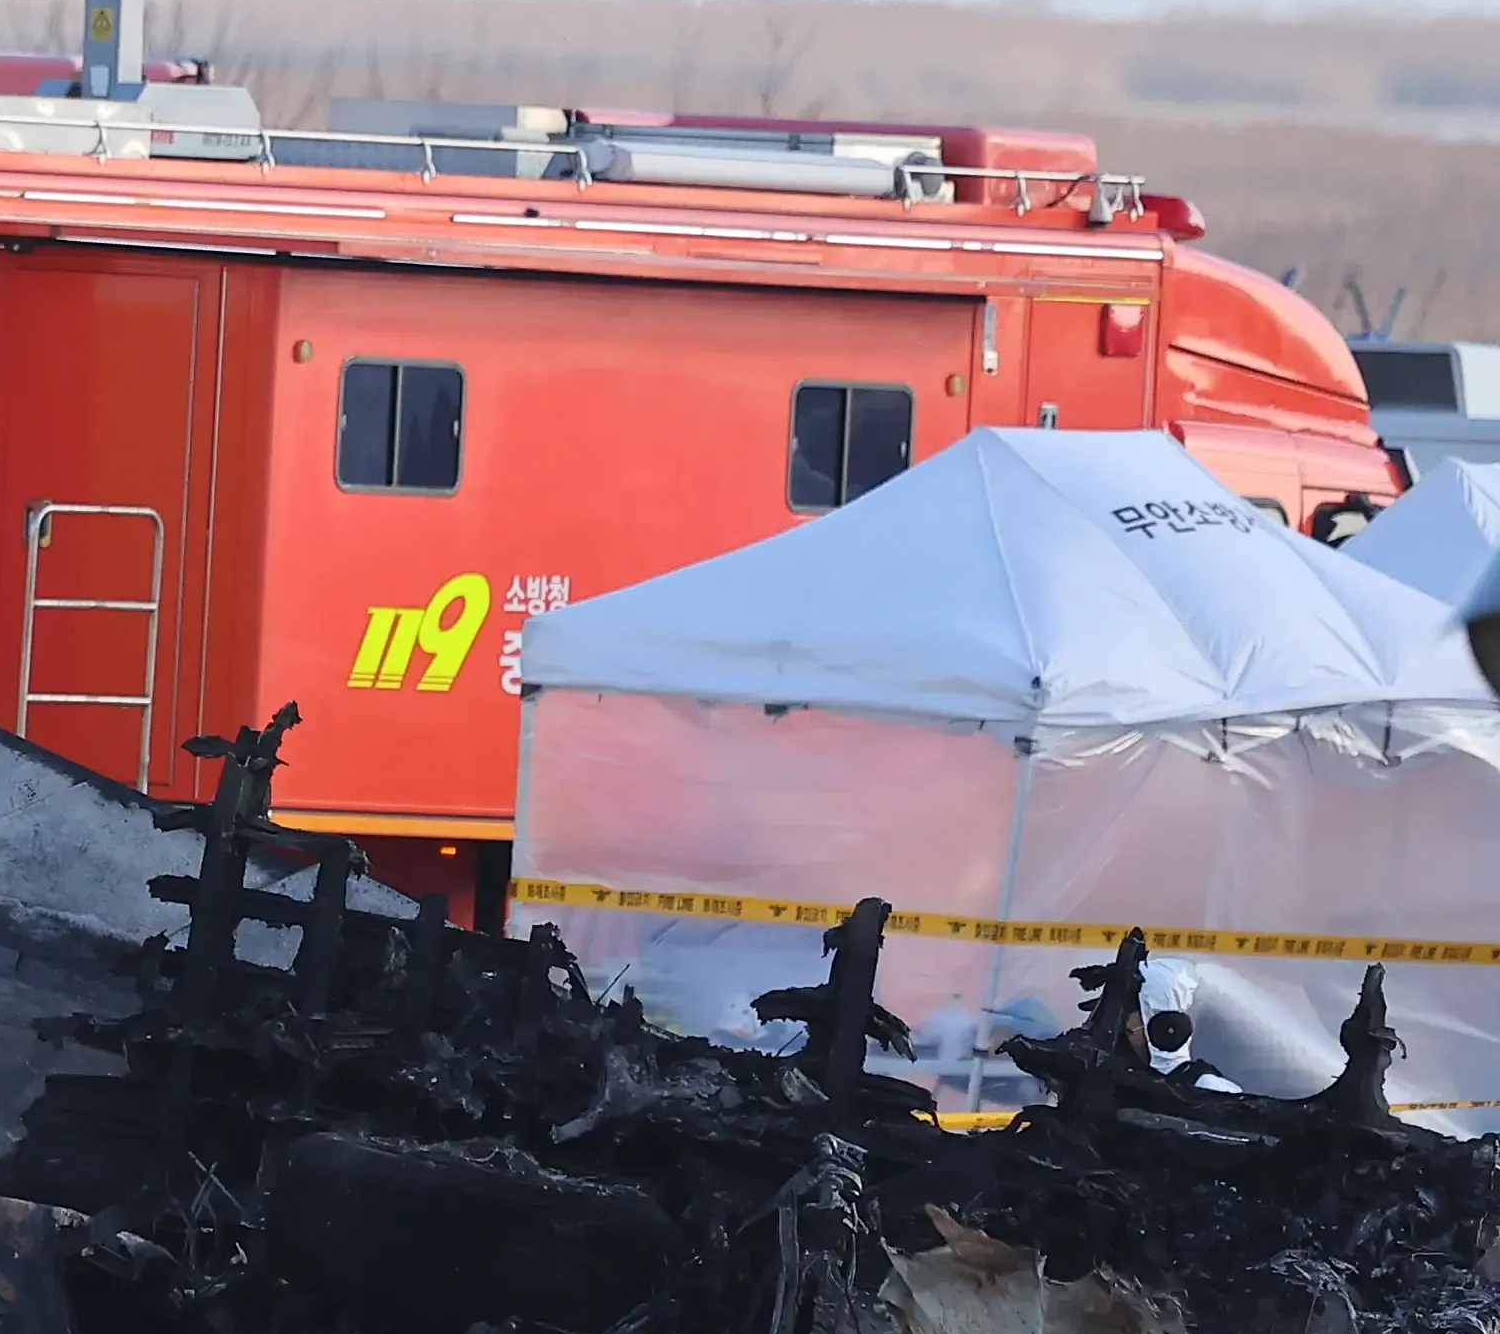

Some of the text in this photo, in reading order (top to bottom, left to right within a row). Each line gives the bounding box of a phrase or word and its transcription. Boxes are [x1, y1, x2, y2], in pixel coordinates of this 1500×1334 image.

[1111, 500, 1255, 540] 무안소방
[503, 575, 569, 615] 소방청
[348, 571, 491, 692] 119
